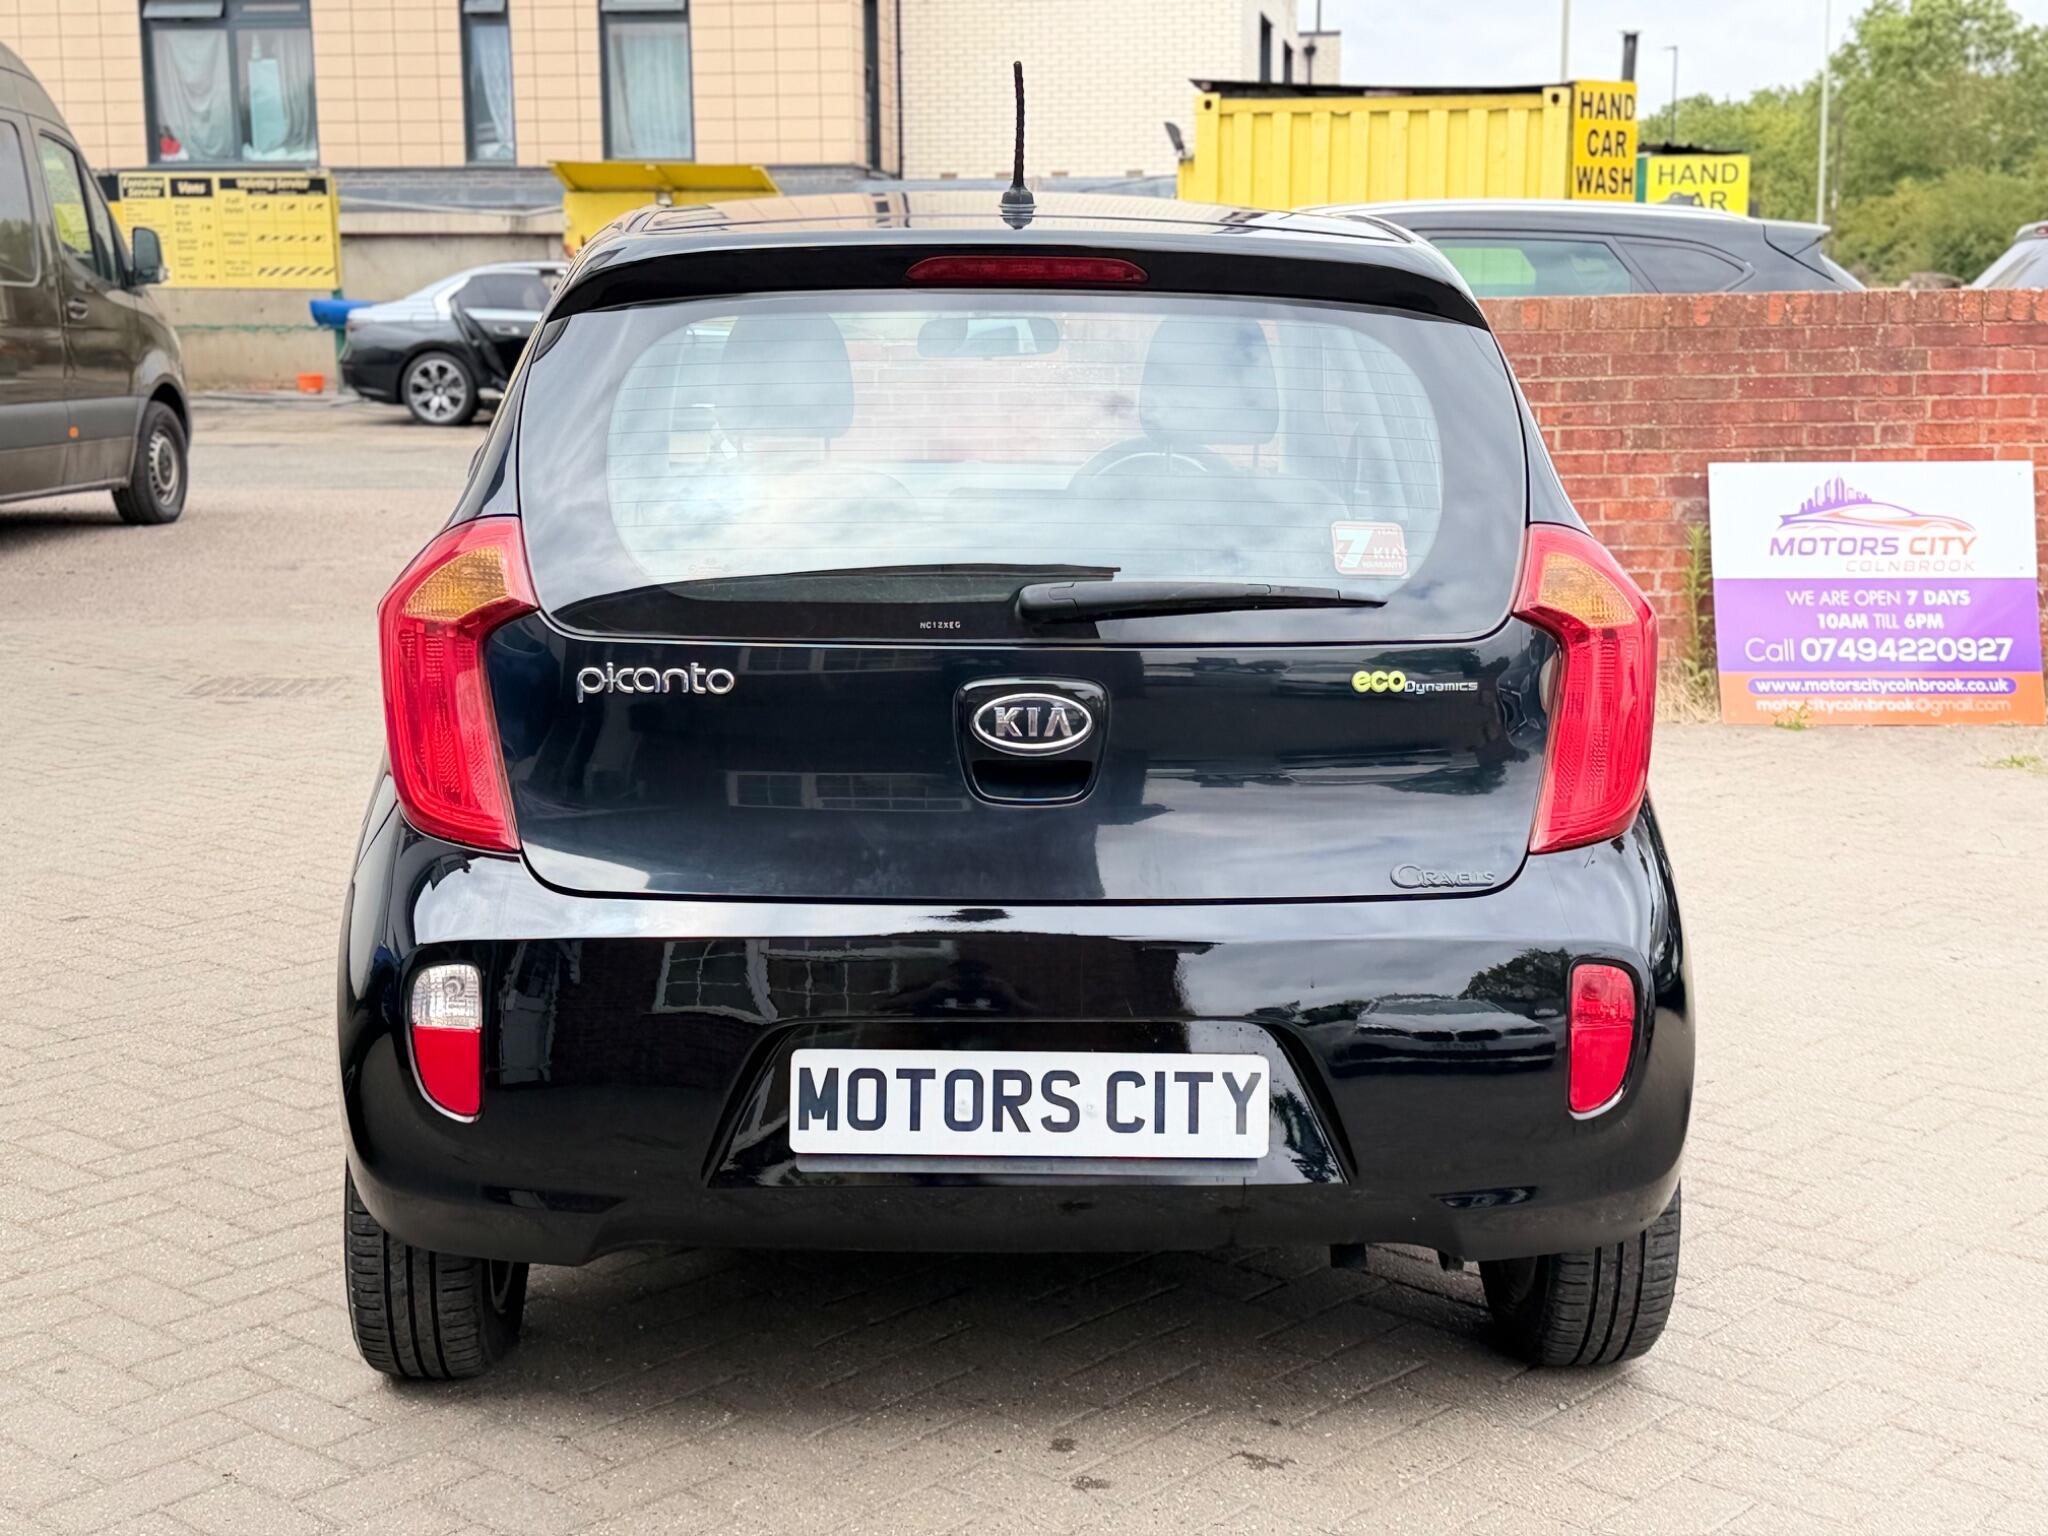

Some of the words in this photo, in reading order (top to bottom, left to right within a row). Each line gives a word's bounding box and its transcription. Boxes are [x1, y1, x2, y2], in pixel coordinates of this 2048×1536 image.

[1579, 91, 1635, 120] HAND
[1587, 129, 1627, 158] CAR
[1576, 165, 1633, 195] WASH
[1658, 162, 1739, 186] HAND
[1691, 191, 1728, 211] AR
[1335, 529, 1374, 568] 7
[1769, 537, 1899, 556] MOTORS
[1908, 536, 1977, 556] CITY
[1846, 559, 1976, 573] COLNBROOK
[1786, 591, 1814, 606] WE
[1819, 590, 1849, 606] ARE
[1854, 590, 1900, 606] OPEN
[1906, 590, 1919, 606] 7
[1923, 590, 1971, 606] DAYS
[1817, 613, 1868, 629] 10AM
[1873, 613, 1898, 629] TILL
[1904, 613, 1944, 629] 6PM
[1745, 637, 1795, 662] Call
[1800, 637, 2014, 662] 07494220927
[576, 662, 734, 704] picanto
[993, 706, 1073, 737] KIA
[797, 1067, 1081, 1133] MOTORS
[1106, 1070, 1262, 1136] CITY
